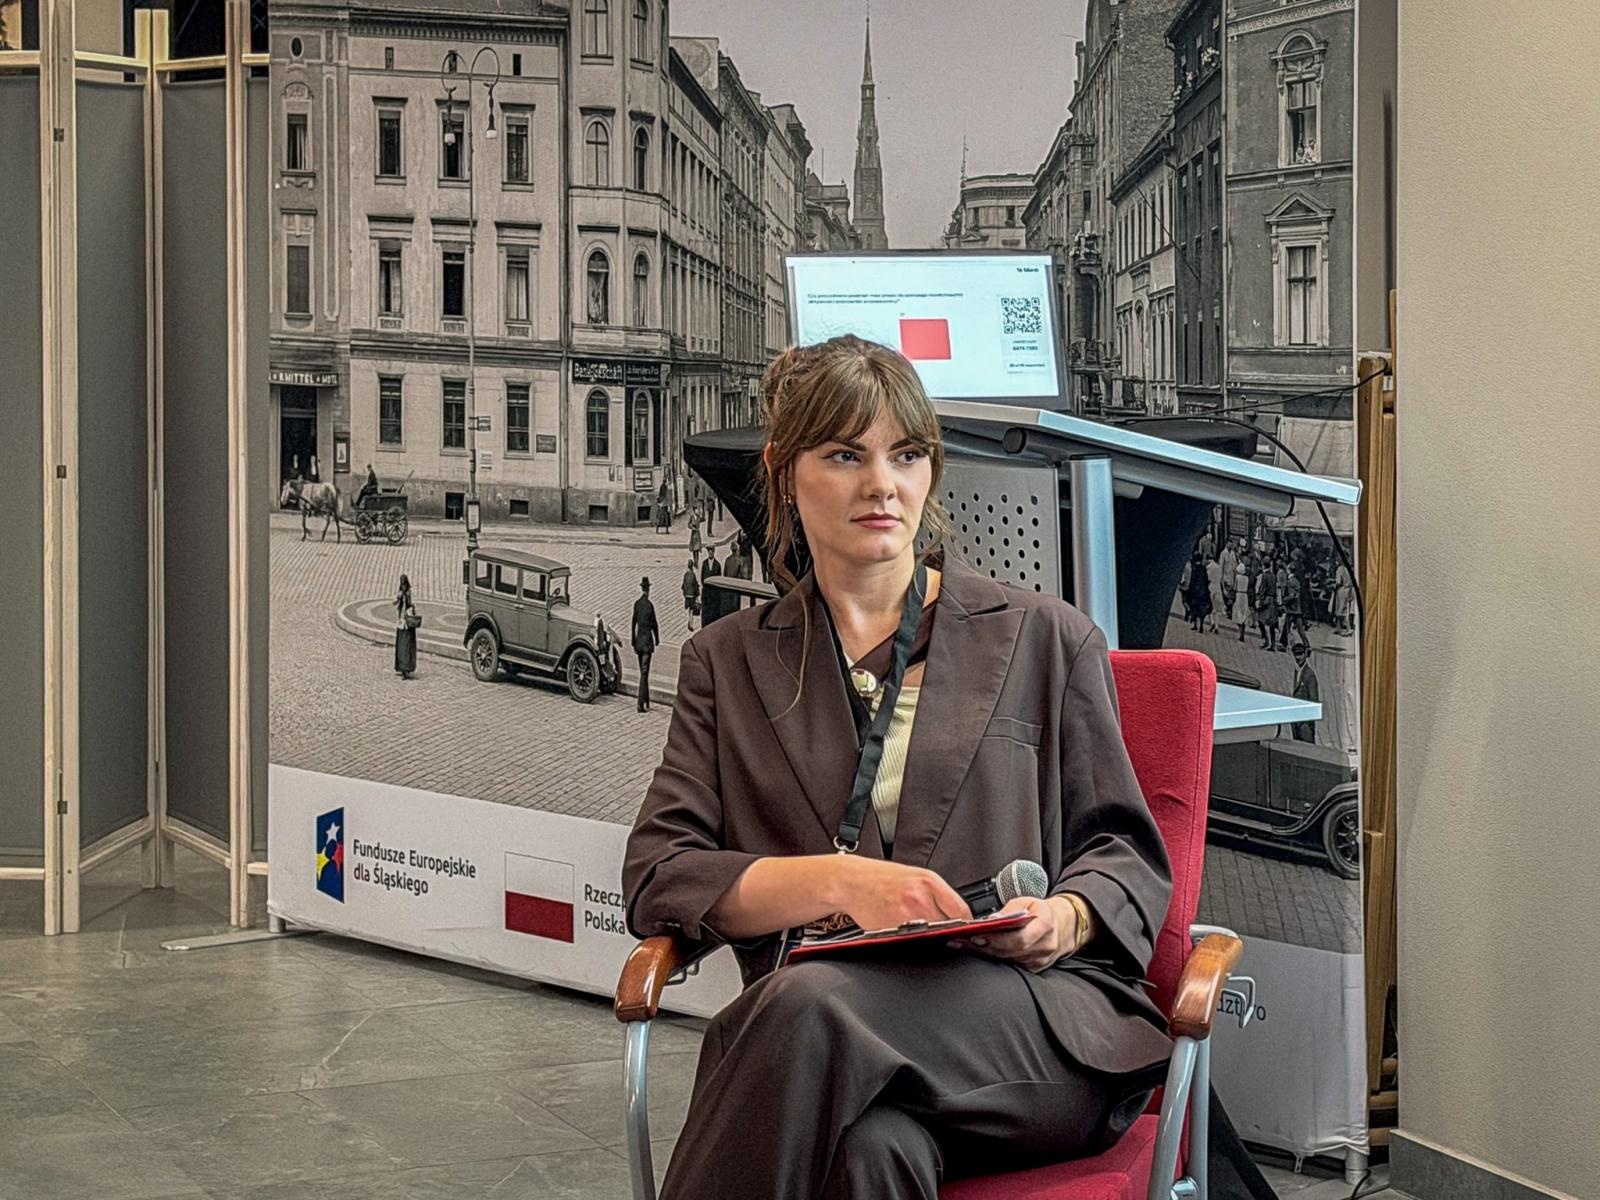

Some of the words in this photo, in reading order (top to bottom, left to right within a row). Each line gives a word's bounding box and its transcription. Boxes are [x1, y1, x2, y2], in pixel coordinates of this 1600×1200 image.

[353, 839, 405, 865] Fundusze
[409, 850, 476, 878] Europejskie
[353, 863, 370, 882] dla
[373, 863, 429, 896] Śląskiego
[584, 910, 626, 935] Polska
